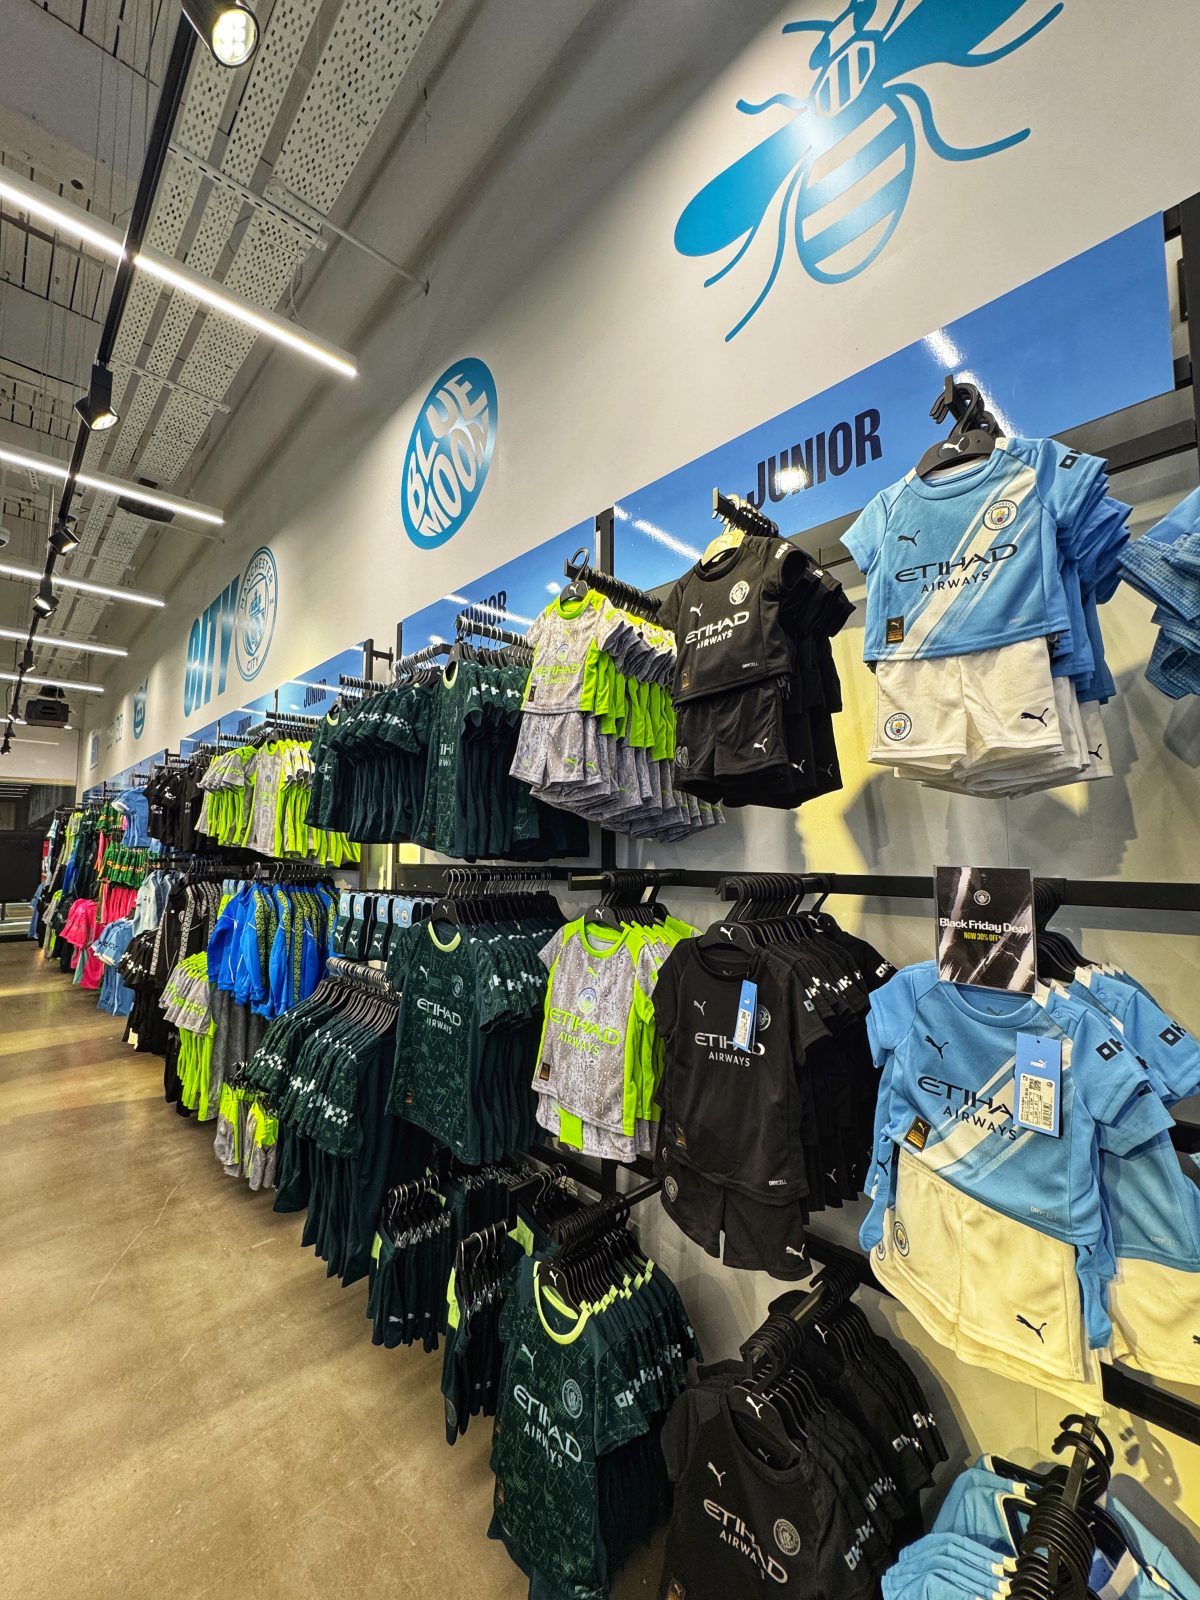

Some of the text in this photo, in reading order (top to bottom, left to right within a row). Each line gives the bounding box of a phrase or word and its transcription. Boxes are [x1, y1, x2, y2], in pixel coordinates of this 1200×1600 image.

[407, 373, 489, 532] BLUE
[746, 408, 883, 511] JUNIOR
[418, 408, 490, 536] MOON
[895, 543, 1018, 583] ETIHAD
[921, 570, 989, 594] AIRWAYS
[184, 574, 240, 718] CITY
[685, 611, 750, 645] ETIHAD
[696, 629, 733, 651] AIRWAYS
[246, 655, 265, 672] CITY
[939, 917, 1028, 934] Black Friday Deal
[963, 931, 976, 940] NOW
[417, 998, 462, 1027] ETIHAD
[549, 1007, 621, 1045] ETIHAD
[557, 1031, 601, 1057] AIRWAYS
[694, 1032, 766, 1056] ETIHD
[708, 1051, 750, 1067] AIRWAYS
[917, 1075, 1014, 1120] ETIHA
[942, 1105, 1017, 1141] AIRWAYS
[513, 1384, 582, 1463] ETIHAD
[523, 1421, 563, 1468] AIRWYS
[703, 1498, 788, 1584] ETIHAD
